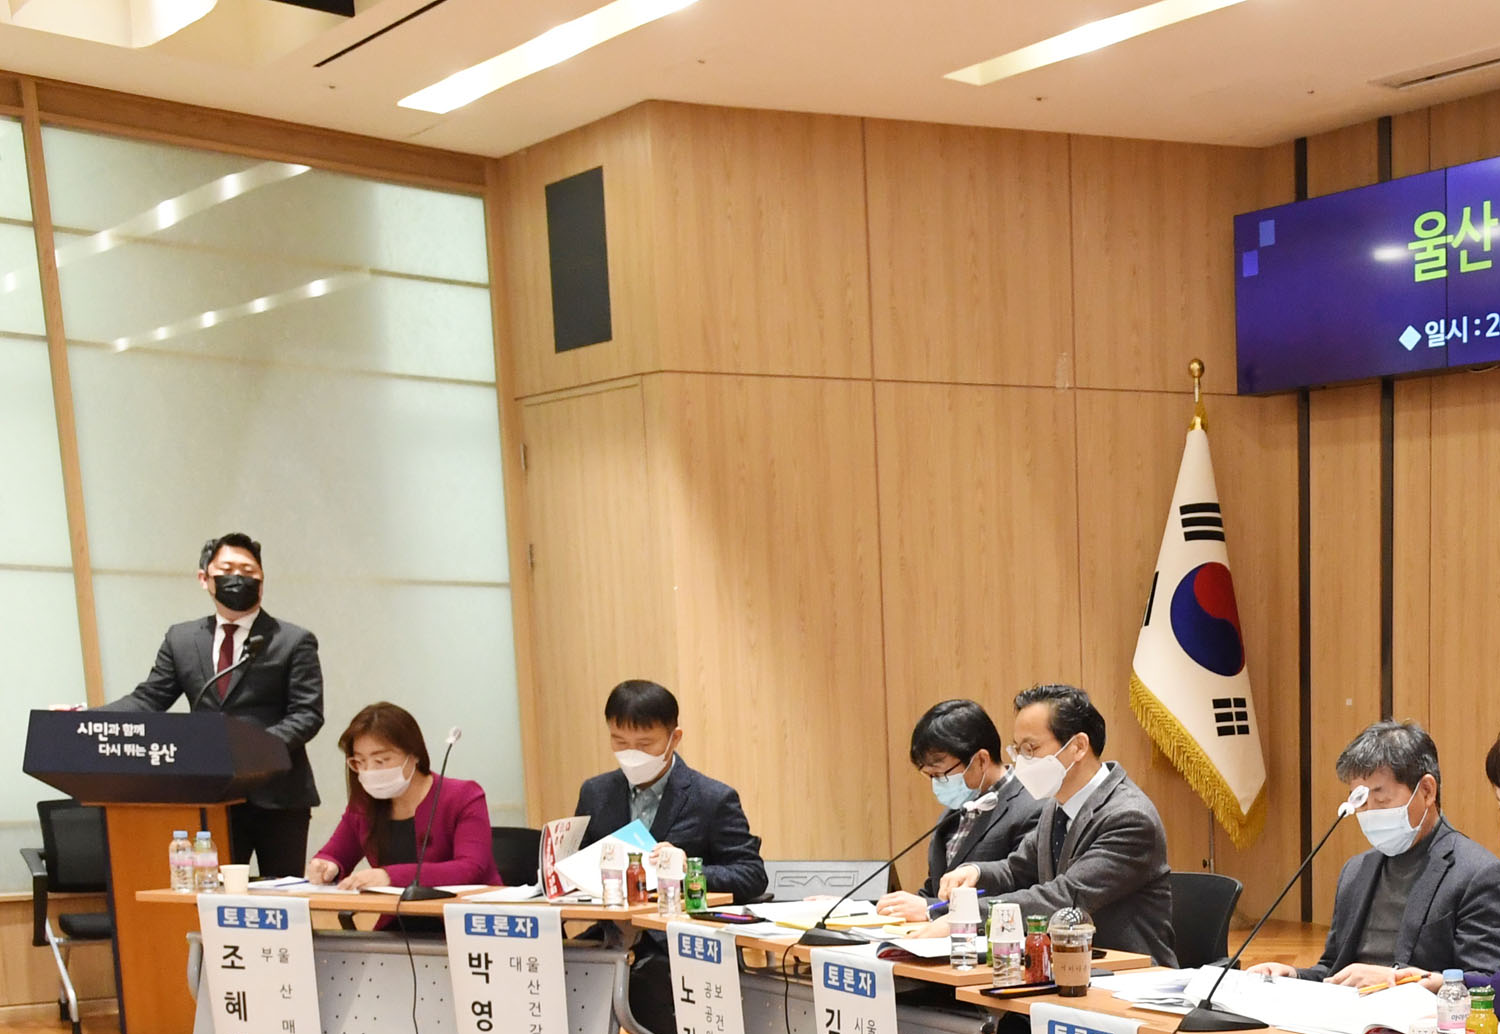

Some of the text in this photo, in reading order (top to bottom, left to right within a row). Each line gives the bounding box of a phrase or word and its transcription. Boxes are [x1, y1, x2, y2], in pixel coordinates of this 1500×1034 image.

[1407, 200, 1500, 282] 울산
[76, 721, 145, 741] 시민과 함께
[98, 743, 177, 766] 다시 뛰는 울산
[222, 906, 285, 929] 토론자
[469, 913, 534, 938] 토론자
[681, 934, 720, 963] 토론자
[827, 966, 873, 997] 토론자
